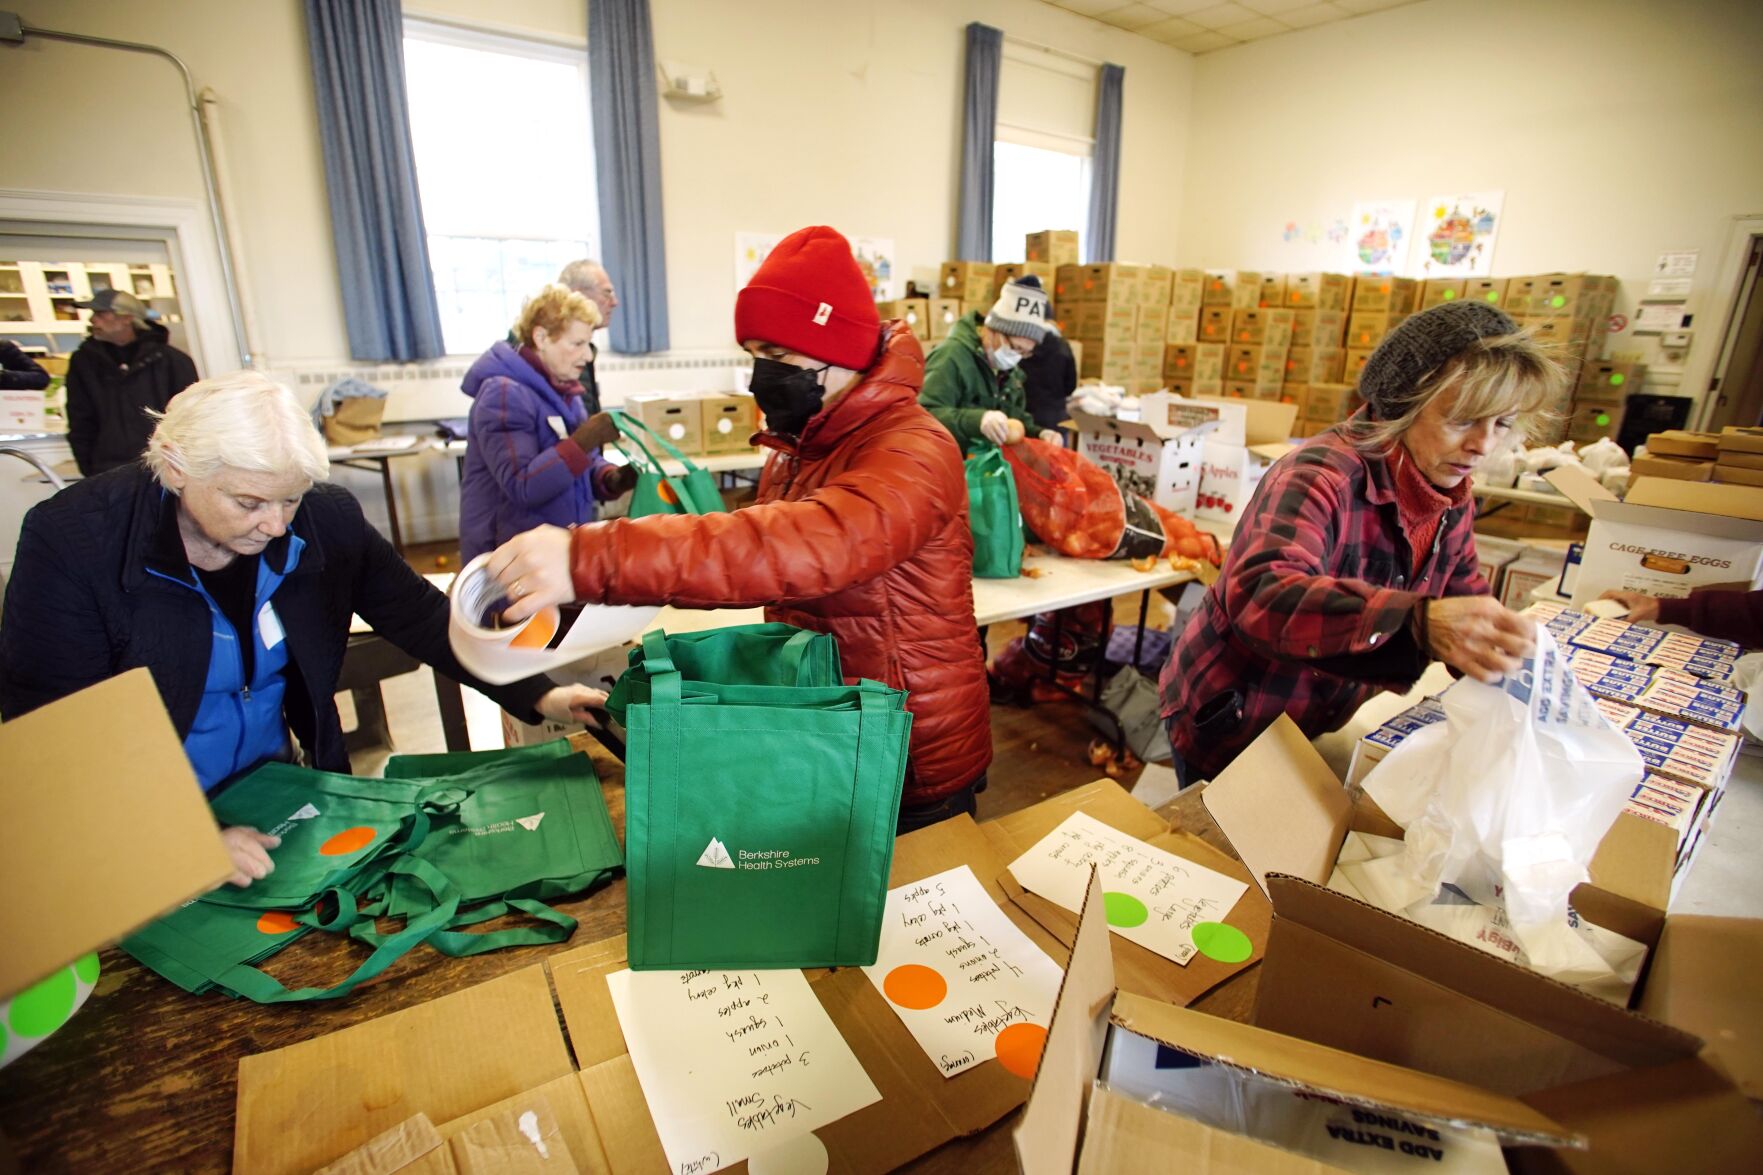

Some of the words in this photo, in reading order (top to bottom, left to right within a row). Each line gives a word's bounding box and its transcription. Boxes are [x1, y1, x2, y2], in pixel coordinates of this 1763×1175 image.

[1086, 442, 1153, 463] VEGETABLES
[1208, 464, 1240, 480] Apples
[1609, 542, 1646, 555] CAGE
[1690, 555, 1732, 569] EGGS
[739, 849, 790, 860] Berkshire
[738, 860, 773, 870] Health
[774, 857, 820, 869] Systems
[1173, 866, 1191, 878] 6
[904, 887, 930, 904] apples
[935, 882, 946, 896] 5
[927, 900, 947, 916] pkg
[951, 903, 960, 915] 1
[944, 921, 961, 934] pkg
[964, 920, 975, 931] 1
[945, 936, 976, 959] squash
[979, 935, 991, 946] 1
[959, 953, 988, 970] onions
[990, 948, 1000, 959] 2
[1003, 961, 1024, 978] 4
[723, 973, 743, 990] pkg
[753, 973, 761, 986] 1
[687, 985, 717, 1002] celery
[757, 993, 769, 1005] 2
[717, 996, 751, 1019] apples
[944, 1004, 988, 1025] Medium
[775, 1015, 784, 1028] 1
[973, 1000, 1035, 1035] Vegetables
[725, 1015, 767, 1043] squash
[749, 1039, 780, 1057] onion
[785, 1034, 794, 1048] 1
[798, 1051, 811, 1067] 3
[726, 1091, 766, 1117] Small
[737, 1094, 812, 1132] Vegetables
[1351, 1109, 1441, 1142] SAVINGS
[1325, 1124, 1395, 1151] EXTRA
[1399, 1140, 1444, 1161] ADD
